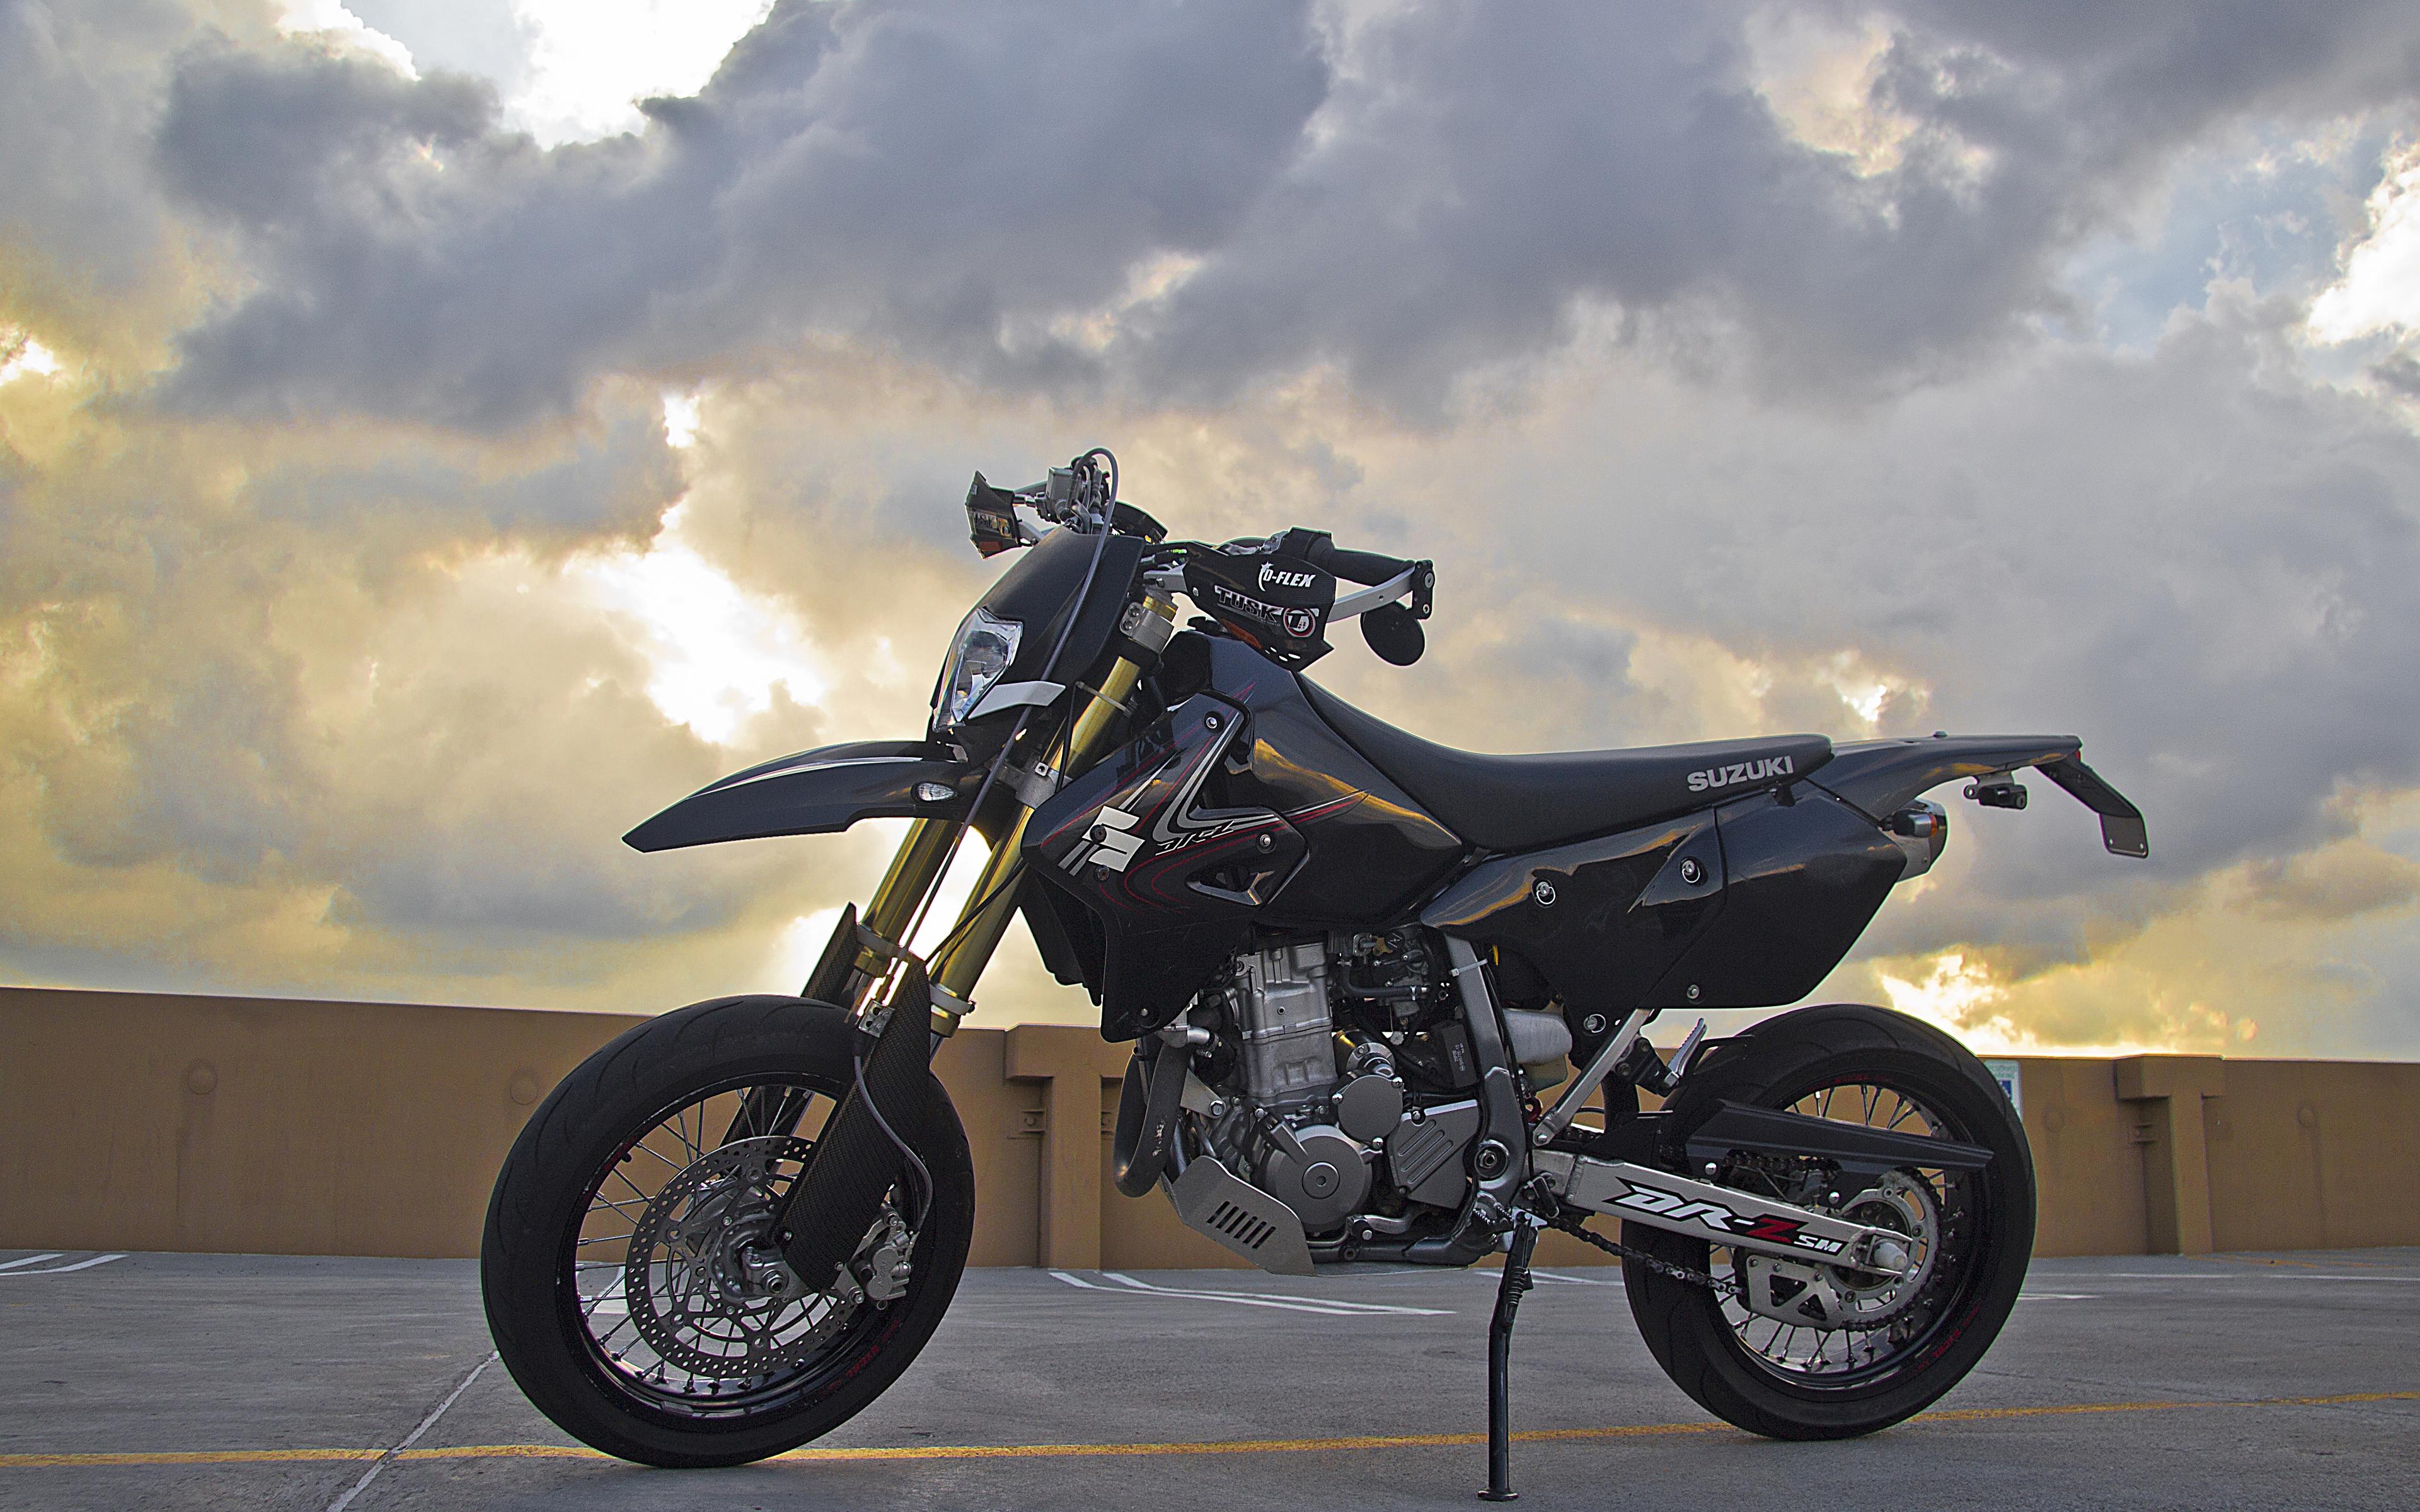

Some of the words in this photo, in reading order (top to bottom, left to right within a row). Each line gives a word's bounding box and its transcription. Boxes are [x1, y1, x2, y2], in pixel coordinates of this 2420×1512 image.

[1262, 568, 1317, 588] D-FLEX
[1215, 585, 1282, 622] TUSK
[1687, 756, 1794, 791] SUZUKI
[1615, 1184, 1800, 1244] DR-Z
[1794, 1234, 1843, 1252] SM
